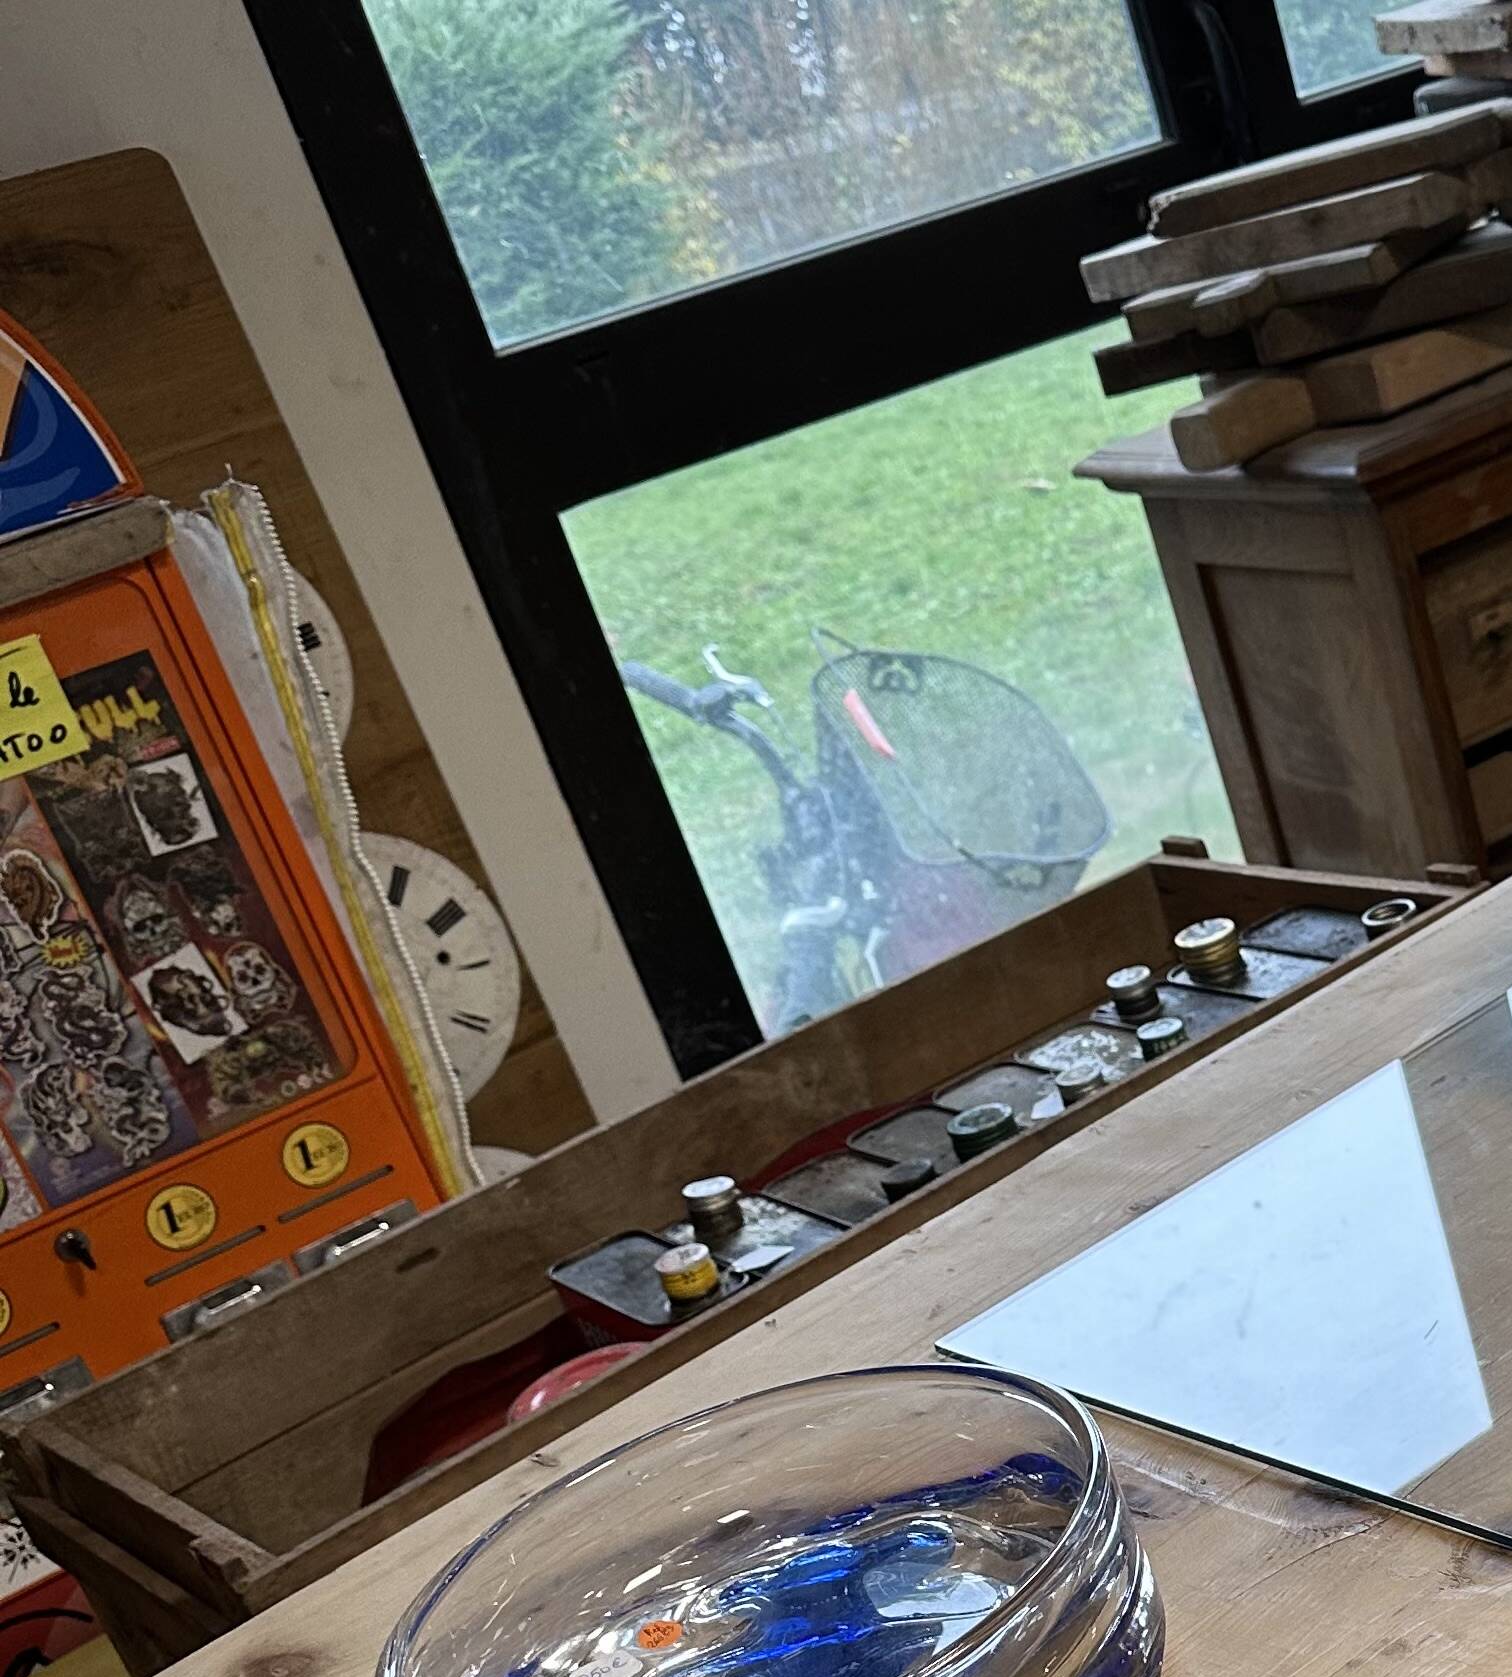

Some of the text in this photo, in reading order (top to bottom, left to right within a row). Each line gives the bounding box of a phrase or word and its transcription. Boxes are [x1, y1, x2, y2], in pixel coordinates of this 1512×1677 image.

[8, 671, 40, 709] le
[78, 685, 162, 744] ULL
[294, 1138, 318, 1172] 1
[157, 1200, 182, 1235] 1
